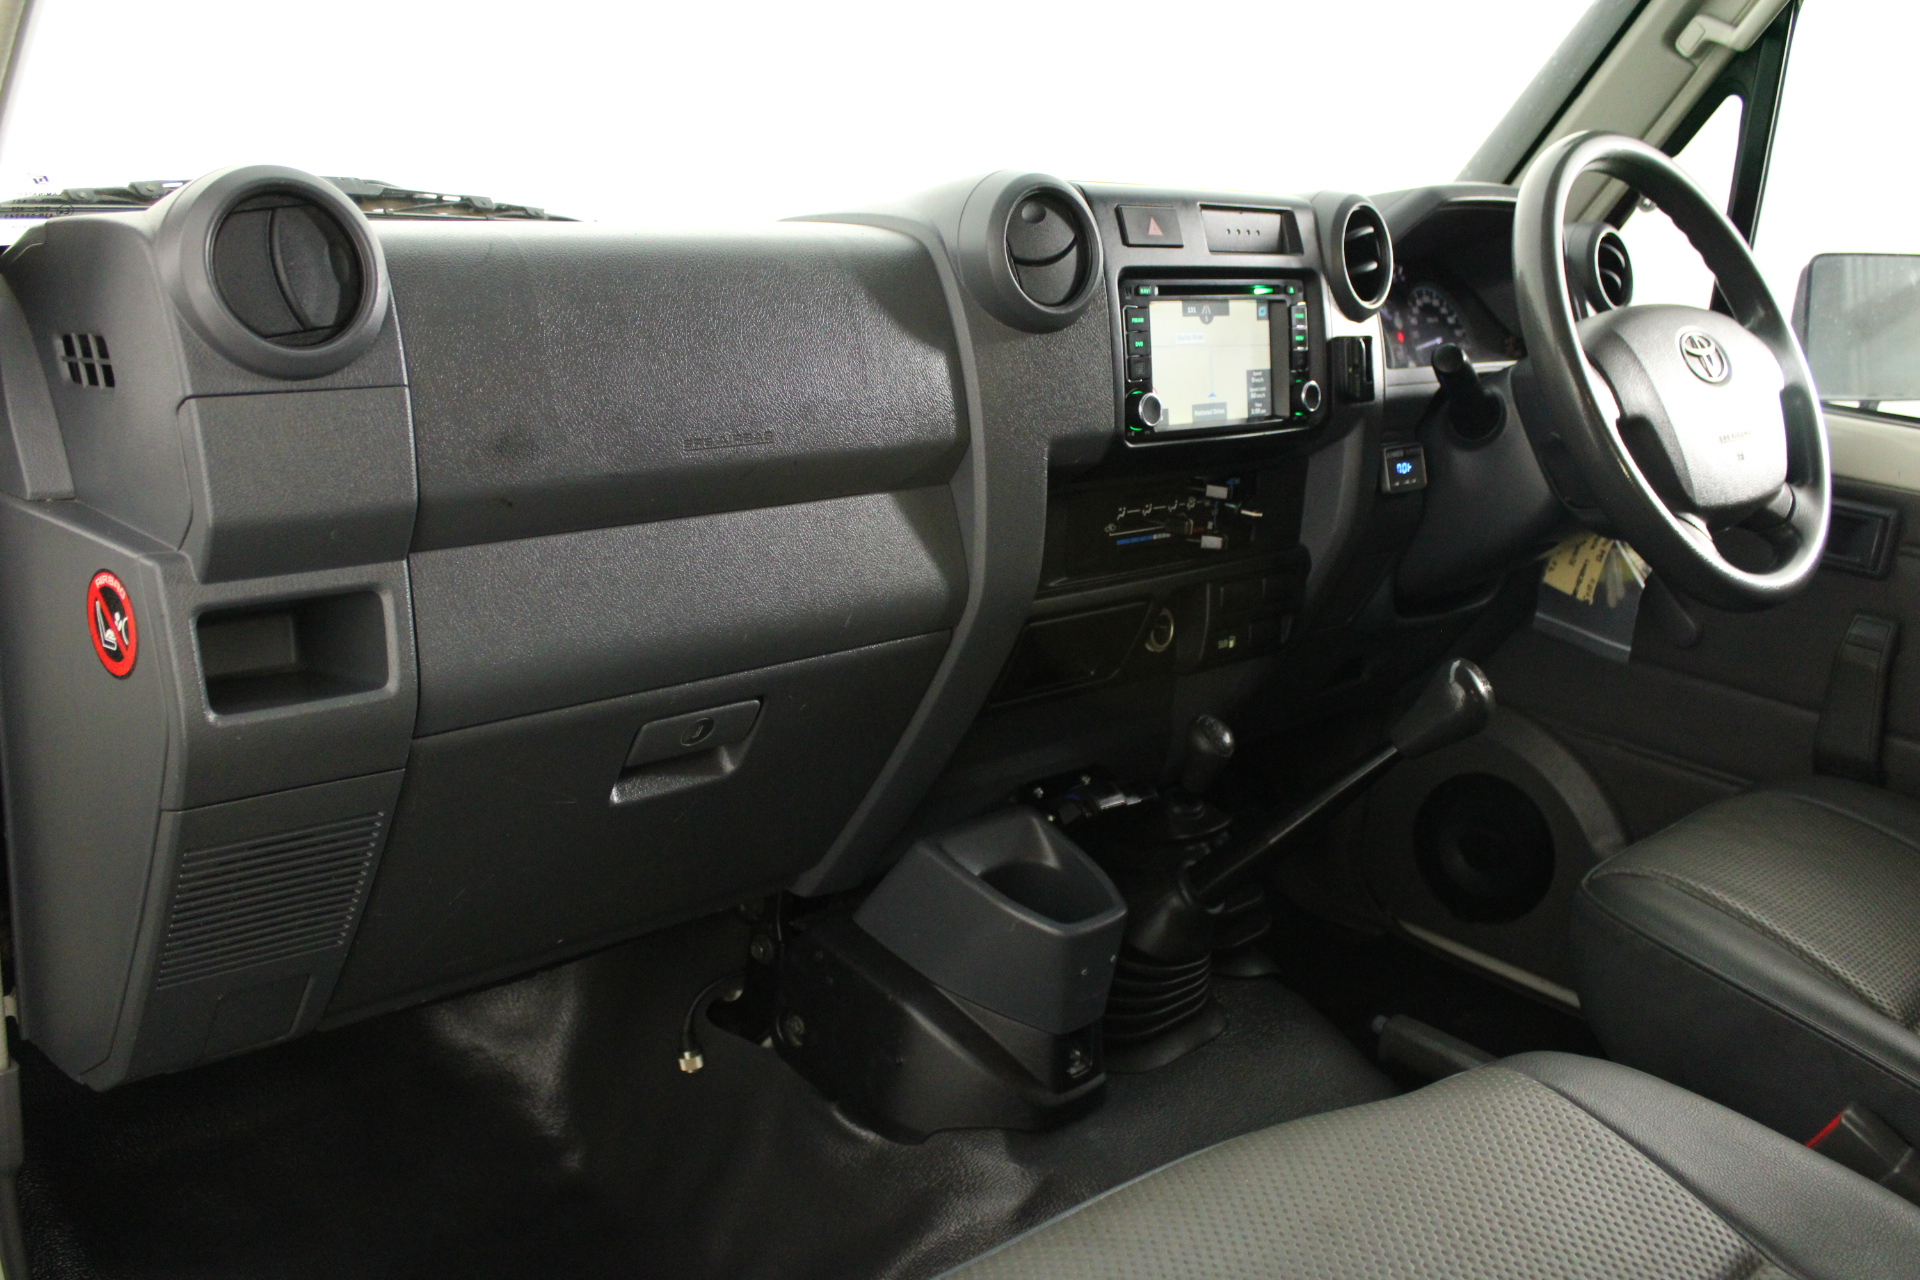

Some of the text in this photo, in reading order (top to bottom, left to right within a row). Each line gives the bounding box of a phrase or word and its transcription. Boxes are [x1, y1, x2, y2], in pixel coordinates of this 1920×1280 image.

[683, 430, 773, 450] SRS AIRBAG
[95, 574, 126, 600] AIRBAG
